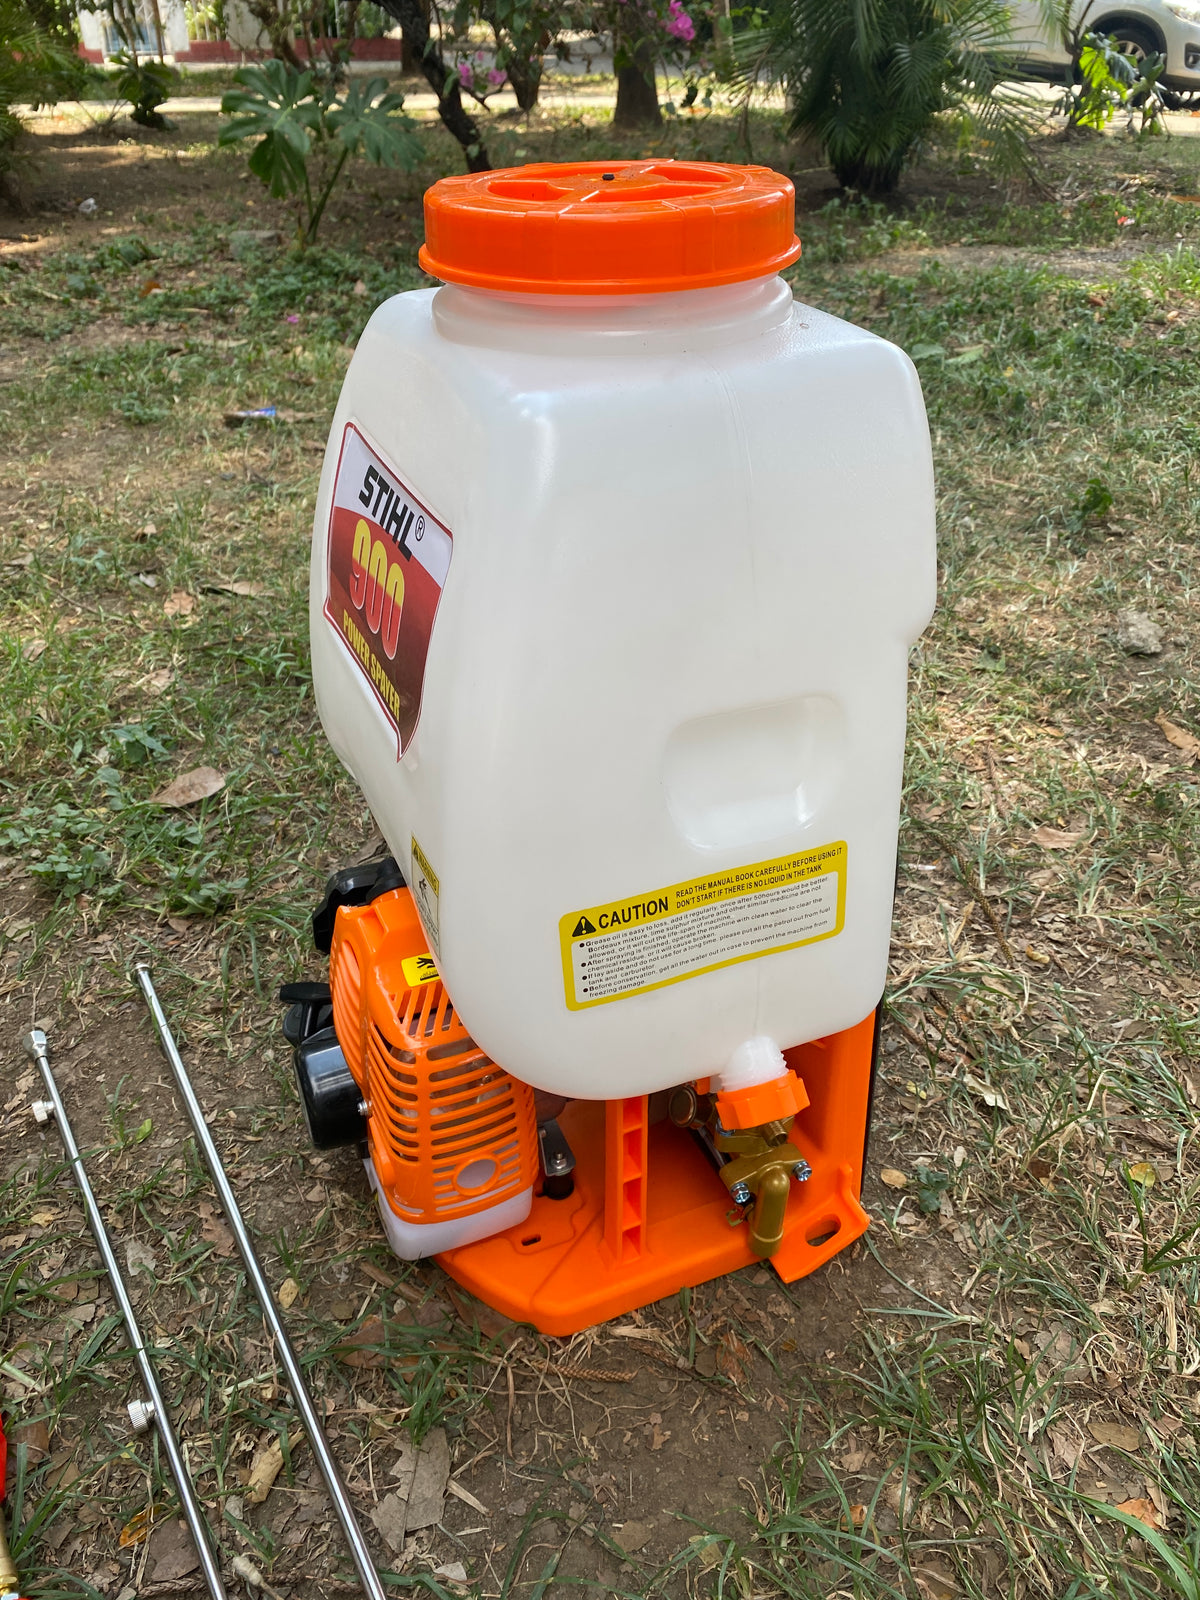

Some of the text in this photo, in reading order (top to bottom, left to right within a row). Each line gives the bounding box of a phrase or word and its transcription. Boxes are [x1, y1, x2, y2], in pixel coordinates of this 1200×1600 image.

[358, 463, 415, 561] STIHL
[349, 518, 405, 660] 900
[343, 609, 401, 722] POWER SPAYER
[675, 847, 841, 897] READ THE MANUAL BOOK CAREFULLY BEFORE USING IT
[676, 898, 694, 908] DON'T
[696, 891, 716, 902] START
[725, 884, 744, 894] THERE
[746, 881, 752, 889] IS
[753, 880, 762, 888] NO
[763, 874, 785, 885] LIQUID
[794, 869, 805, 877] THE
[806, 864, 822, 874] TANK
[586, 937, 610, 946] Grease
[628, 928, 644, 936] easy
[737, 896, 752, 904] after
[781, 884, 799, 893] would
[586, 958, 604, 966] After
[606, 951, 634, 961] spraying
[672, 933, 696, 942] operate
[708, 921, 735, 931] machine
[751, 911, 768, 920] clean
[769, 907, 787, 915] water
[796, 901, 811, 909] clear
[589, 941, 620, 952] Bordeaux
[650, 927, 664, 935] lime
[666, 920, 689, 931] sulphur
[691, 912, 714, 922] mixture
[728, 904, 745, 913] other
[747, 898, 768, 909] similar
[598, 897, 668, 929] CAUTION
[668, 926, 695, 937] life-span
[588, 962, 617, 972] chemical
[673, 939, 693, 948] cause
[590, 981, 612, 990] Before
[690, 954, 707, 962] water
[750, 934, 774, 945] prevent
[787, 926, 812, 935] machine
[605, 966, 624, 974] aside
[687, 943, 701, 951] long
[719, 930, 740, 941] please
[590, 988, 616, 997] freezing
